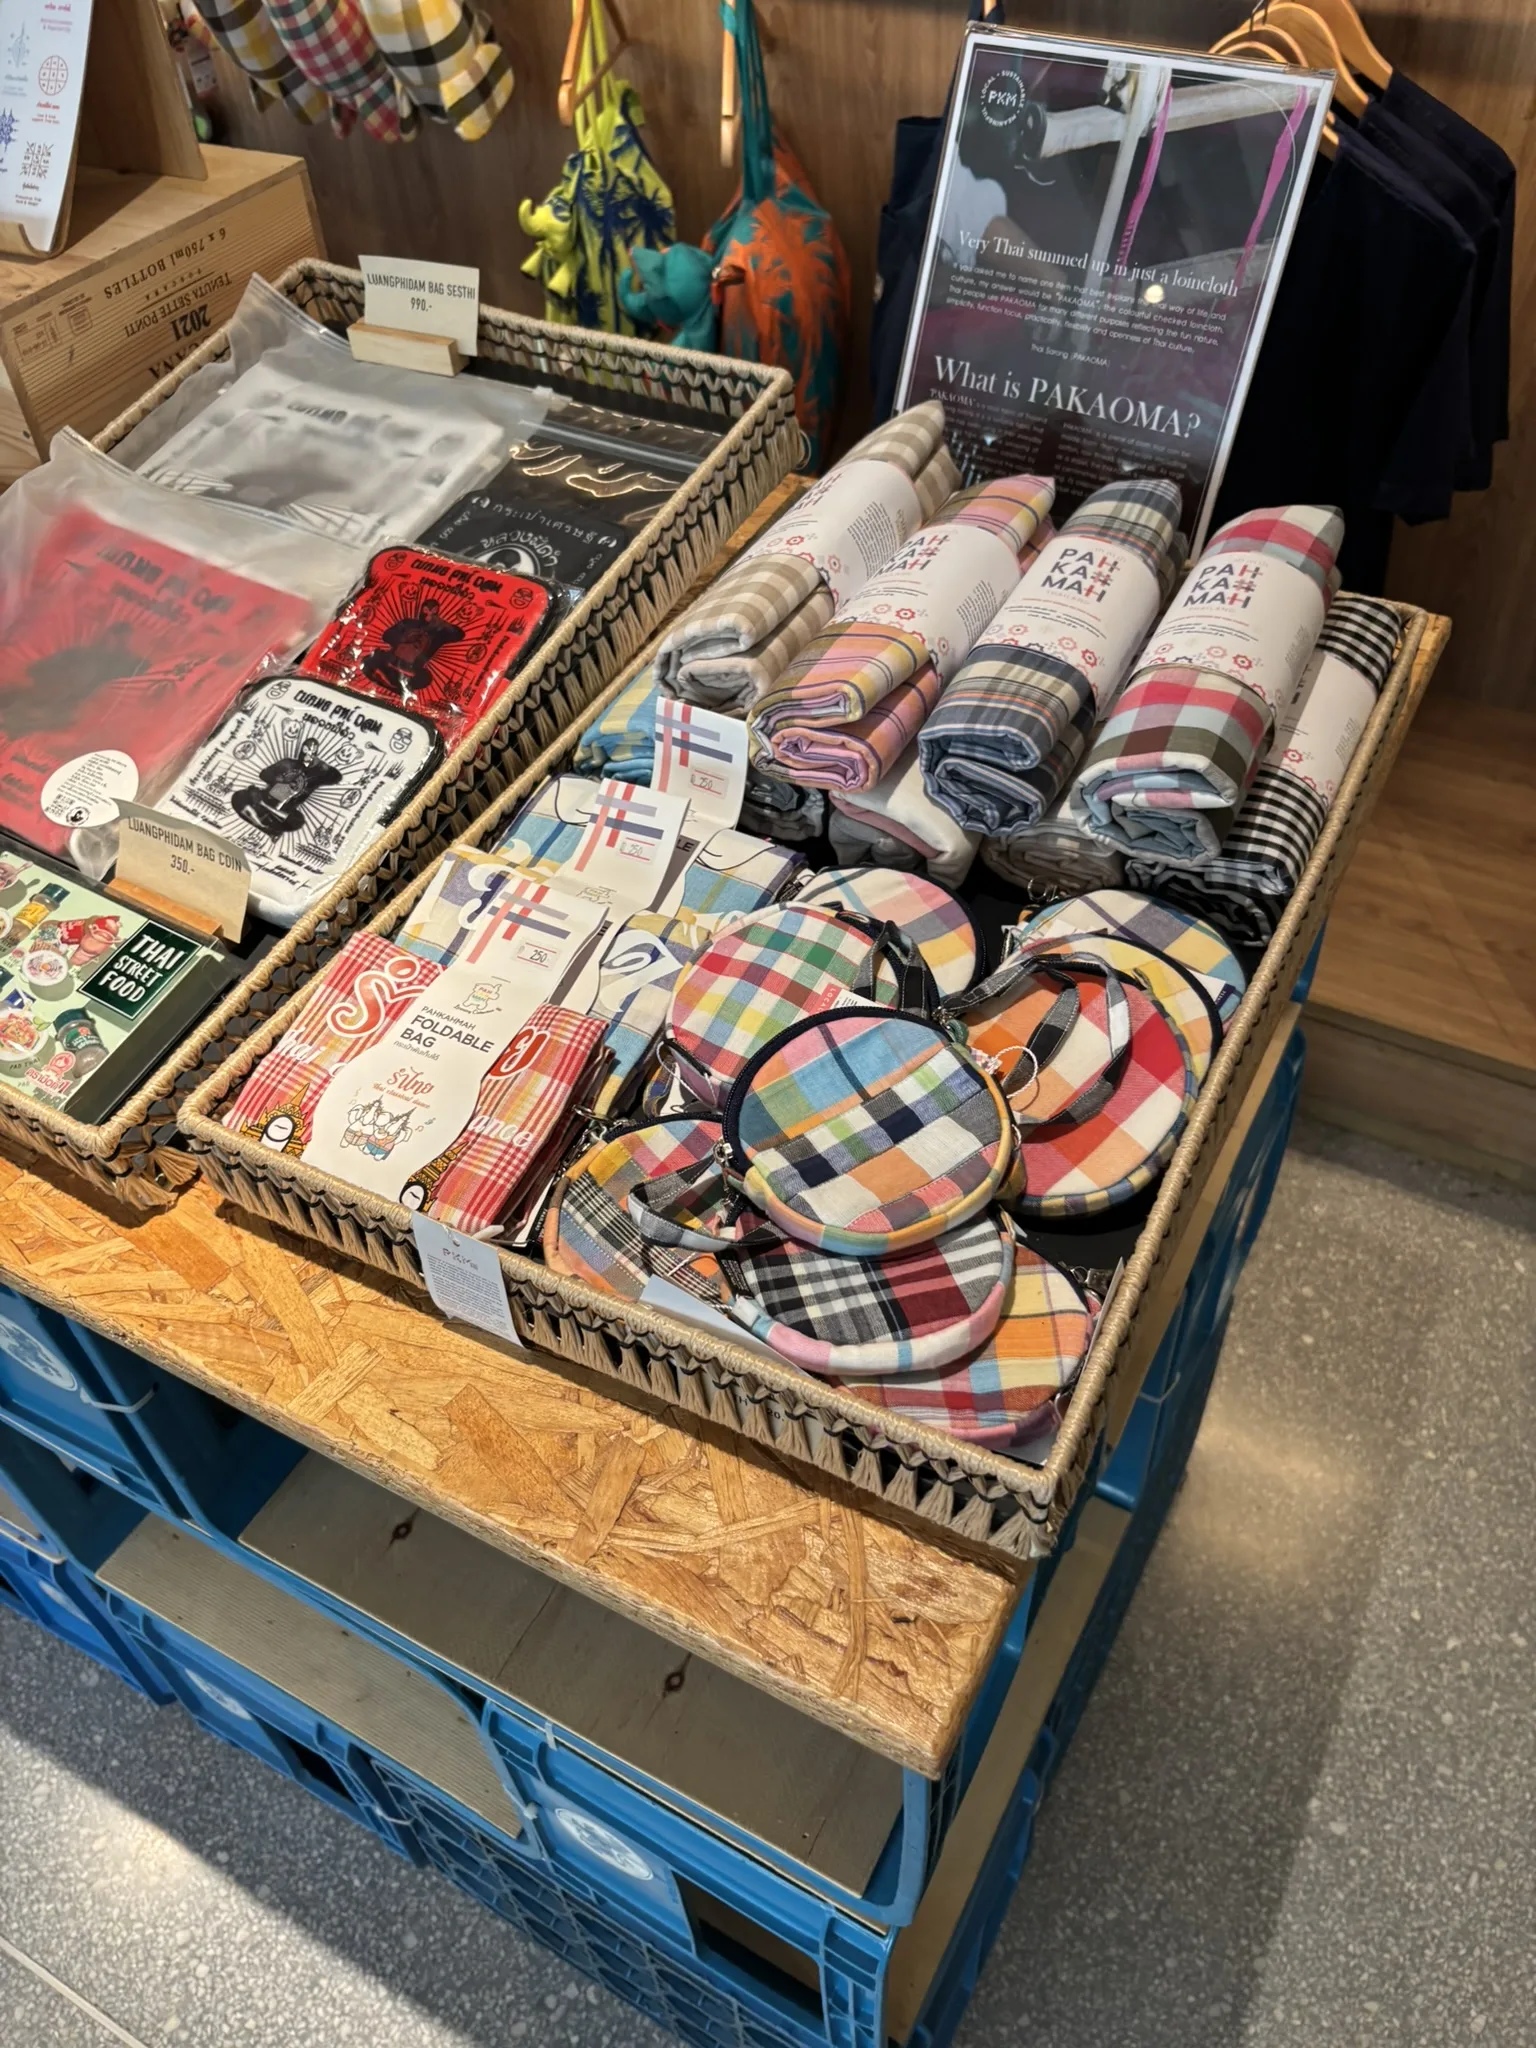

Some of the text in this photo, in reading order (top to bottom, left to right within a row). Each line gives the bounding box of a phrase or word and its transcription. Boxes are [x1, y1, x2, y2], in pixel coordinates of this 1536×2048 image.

[988, 90, 1018, 107] PKM
[218, 227, 227, 240] 6
[960, 229, 1238, 298] Very Thai summed up in just a loincloth
[103, 257, 166, 300] BOTTLES
[193, 271, 231, 300] TENUTA
[367, 273, 476, 300] LUANGPHIDAM BAG SESTHI
[159, 292, 192, 318] SETTE
[999, 295, 1036, 309] PAKAOMA
[1017, 275, 1037, 285] name
[1168, 304, 1184, 314] way
[1210, 311, 1226, 321] and
[124, 307, 158, 338] PONTI
[170, 303, 212, 342] 2021
[1092, 326, 1107, 336] and
[1153, 313, 1187, 327] checked
[933, 355, 1202, 439] What is PAKAOMA?
[1059, 548, 1120, 573] PAH
[1199, 564, 1263, 579] PAH
[1040, 575, 1106, 603] MAH
[1182, 592, 1251, 608] MAH
[128, 816, 243, 873] LUANGPHIDAM BAG COIN
[170, 854, 196, 875] 350.-
[131, 934, 186, 970] THAI
[529, 949, 548, 963] 250
[114, 955, 163, 989] STREET
[99, 970, 146, 1004] FOOD
[421, 1006, 476, 1031] PAHKAHMAH
[400, 1028, 437, 1048] BAG
[411, 1015, 495, 1053] FOLDABLE
[387, 1066, 434, 1096] รำไทย
